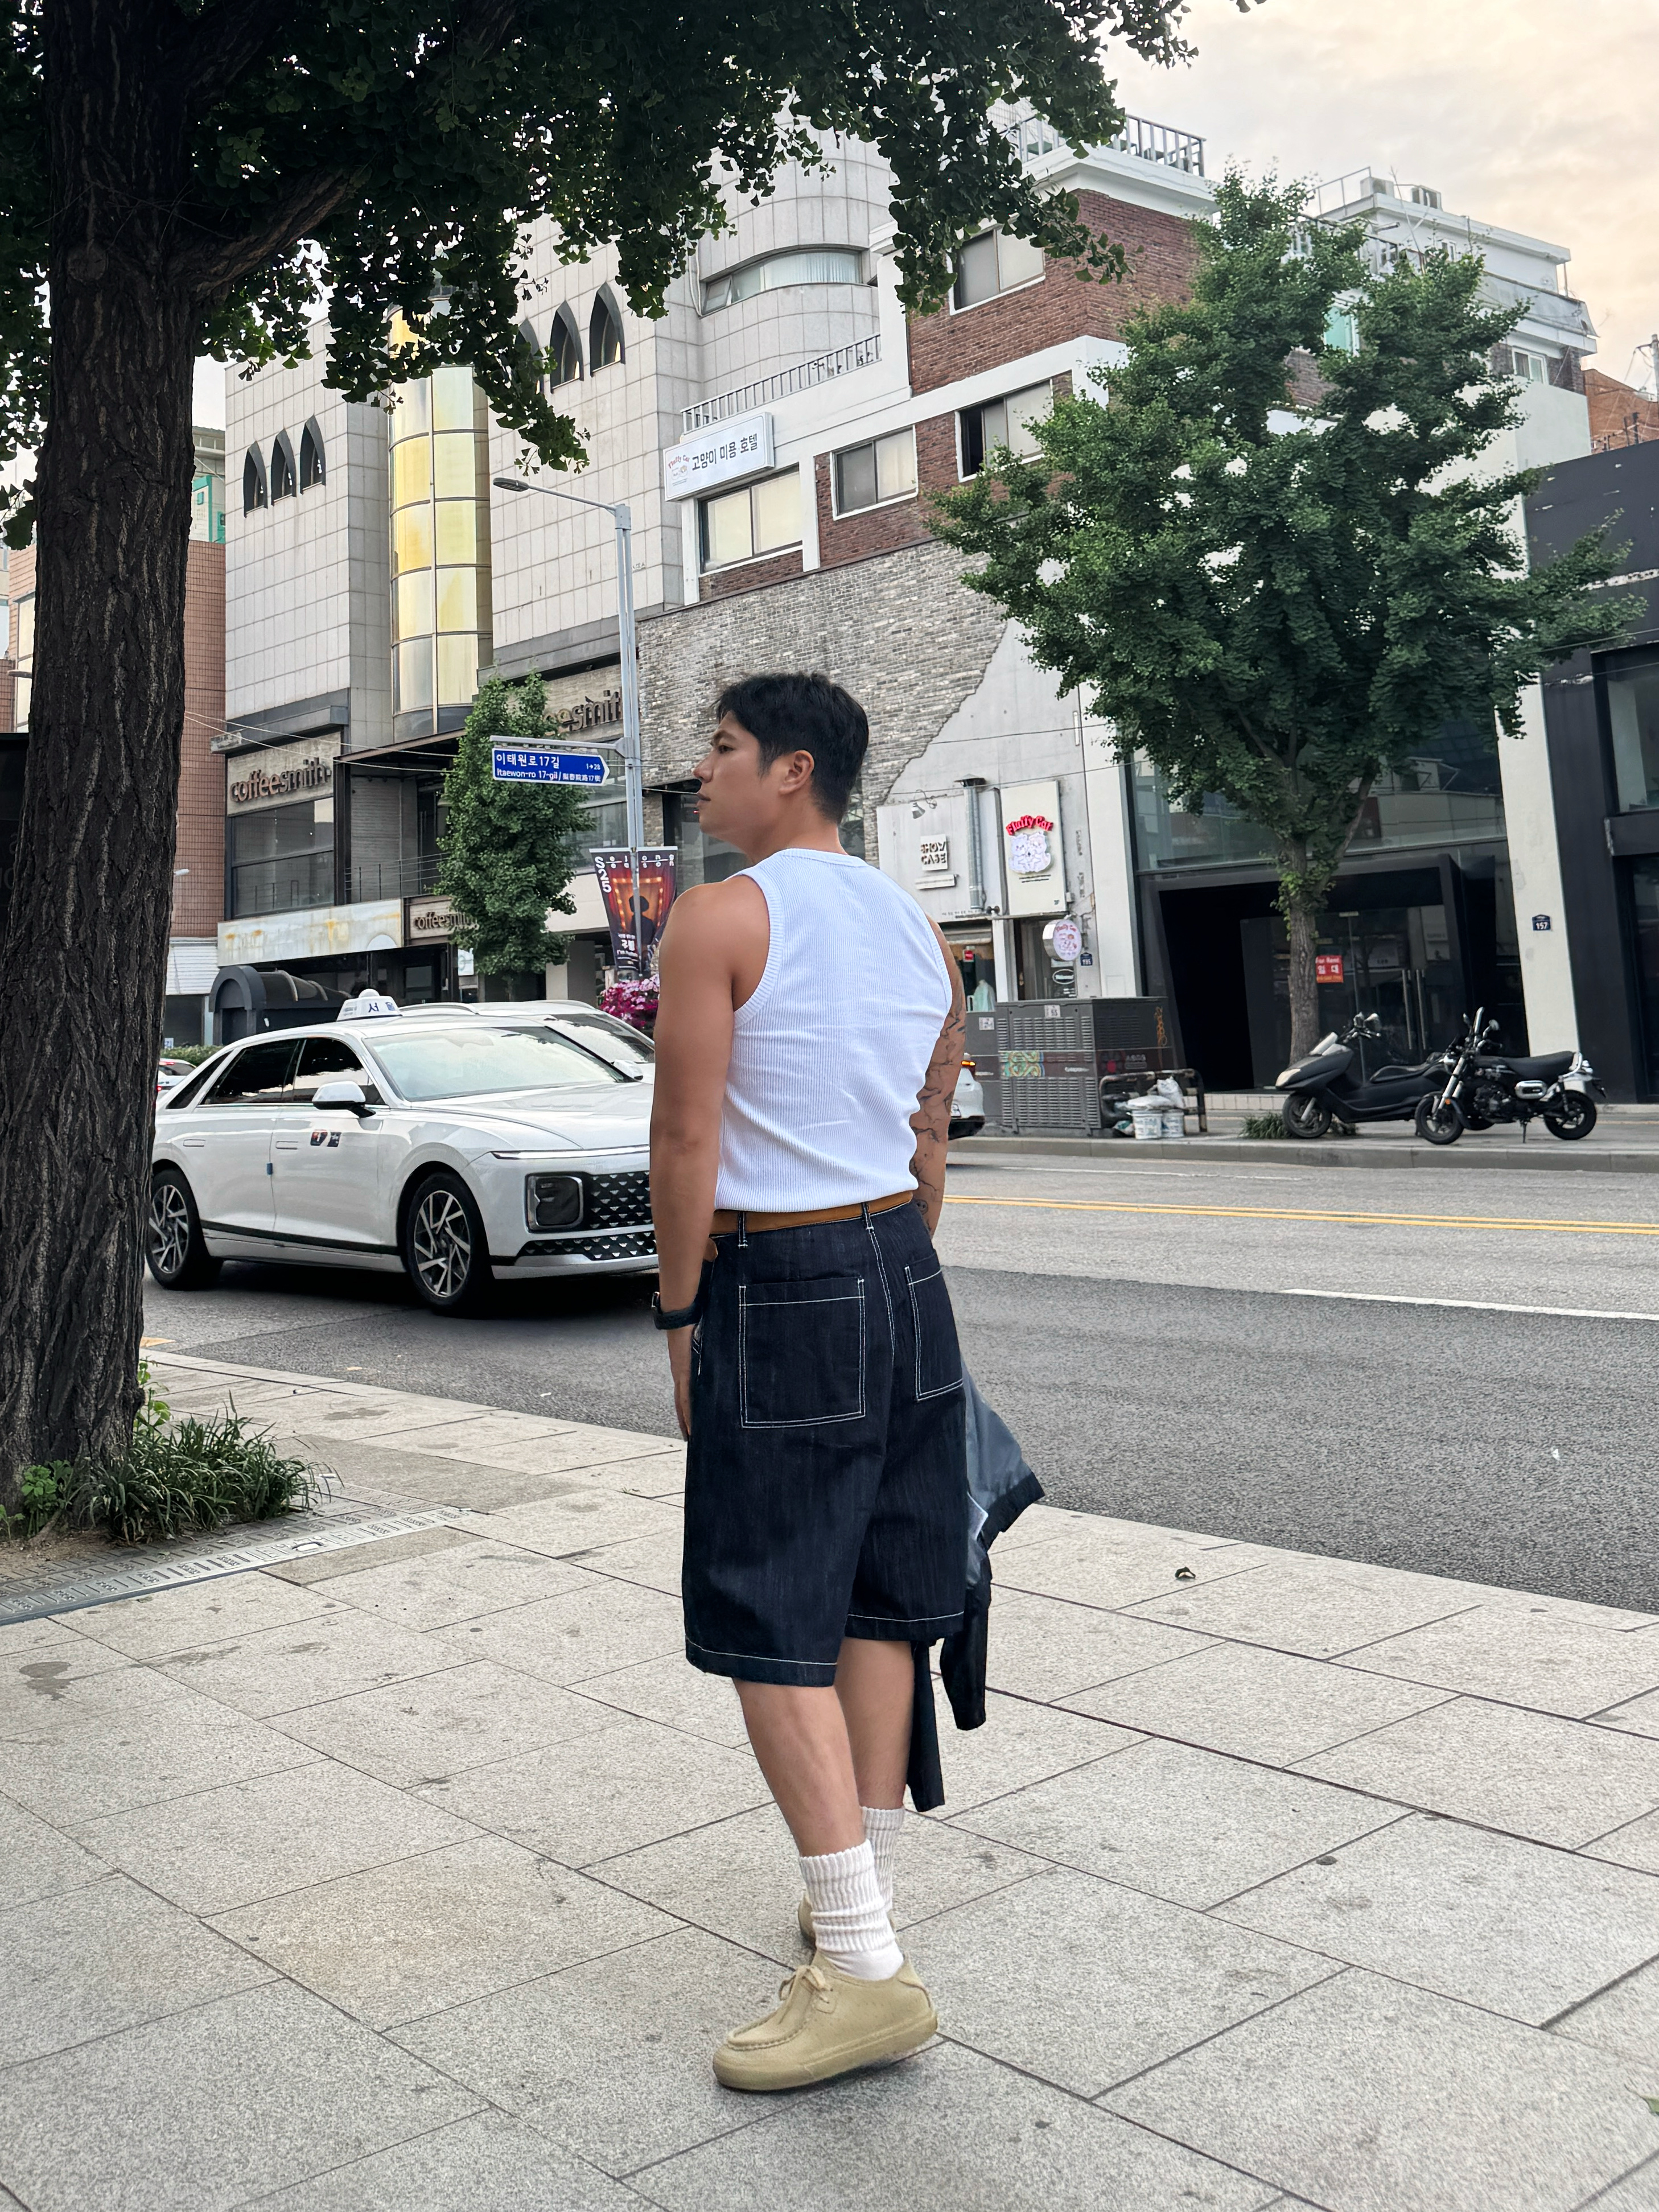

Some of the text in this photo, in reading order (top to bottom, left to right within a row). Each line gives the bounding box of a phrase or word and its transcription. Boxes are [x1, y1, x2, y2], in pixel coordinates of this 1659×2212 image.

[691, 448, 717, 471] 고양이
[497, 768, 536, 778] Itaewon-ro
[1006, 815, 1054, 835] Fluffy Cat
[1535, 921, 1547, 930] 157
